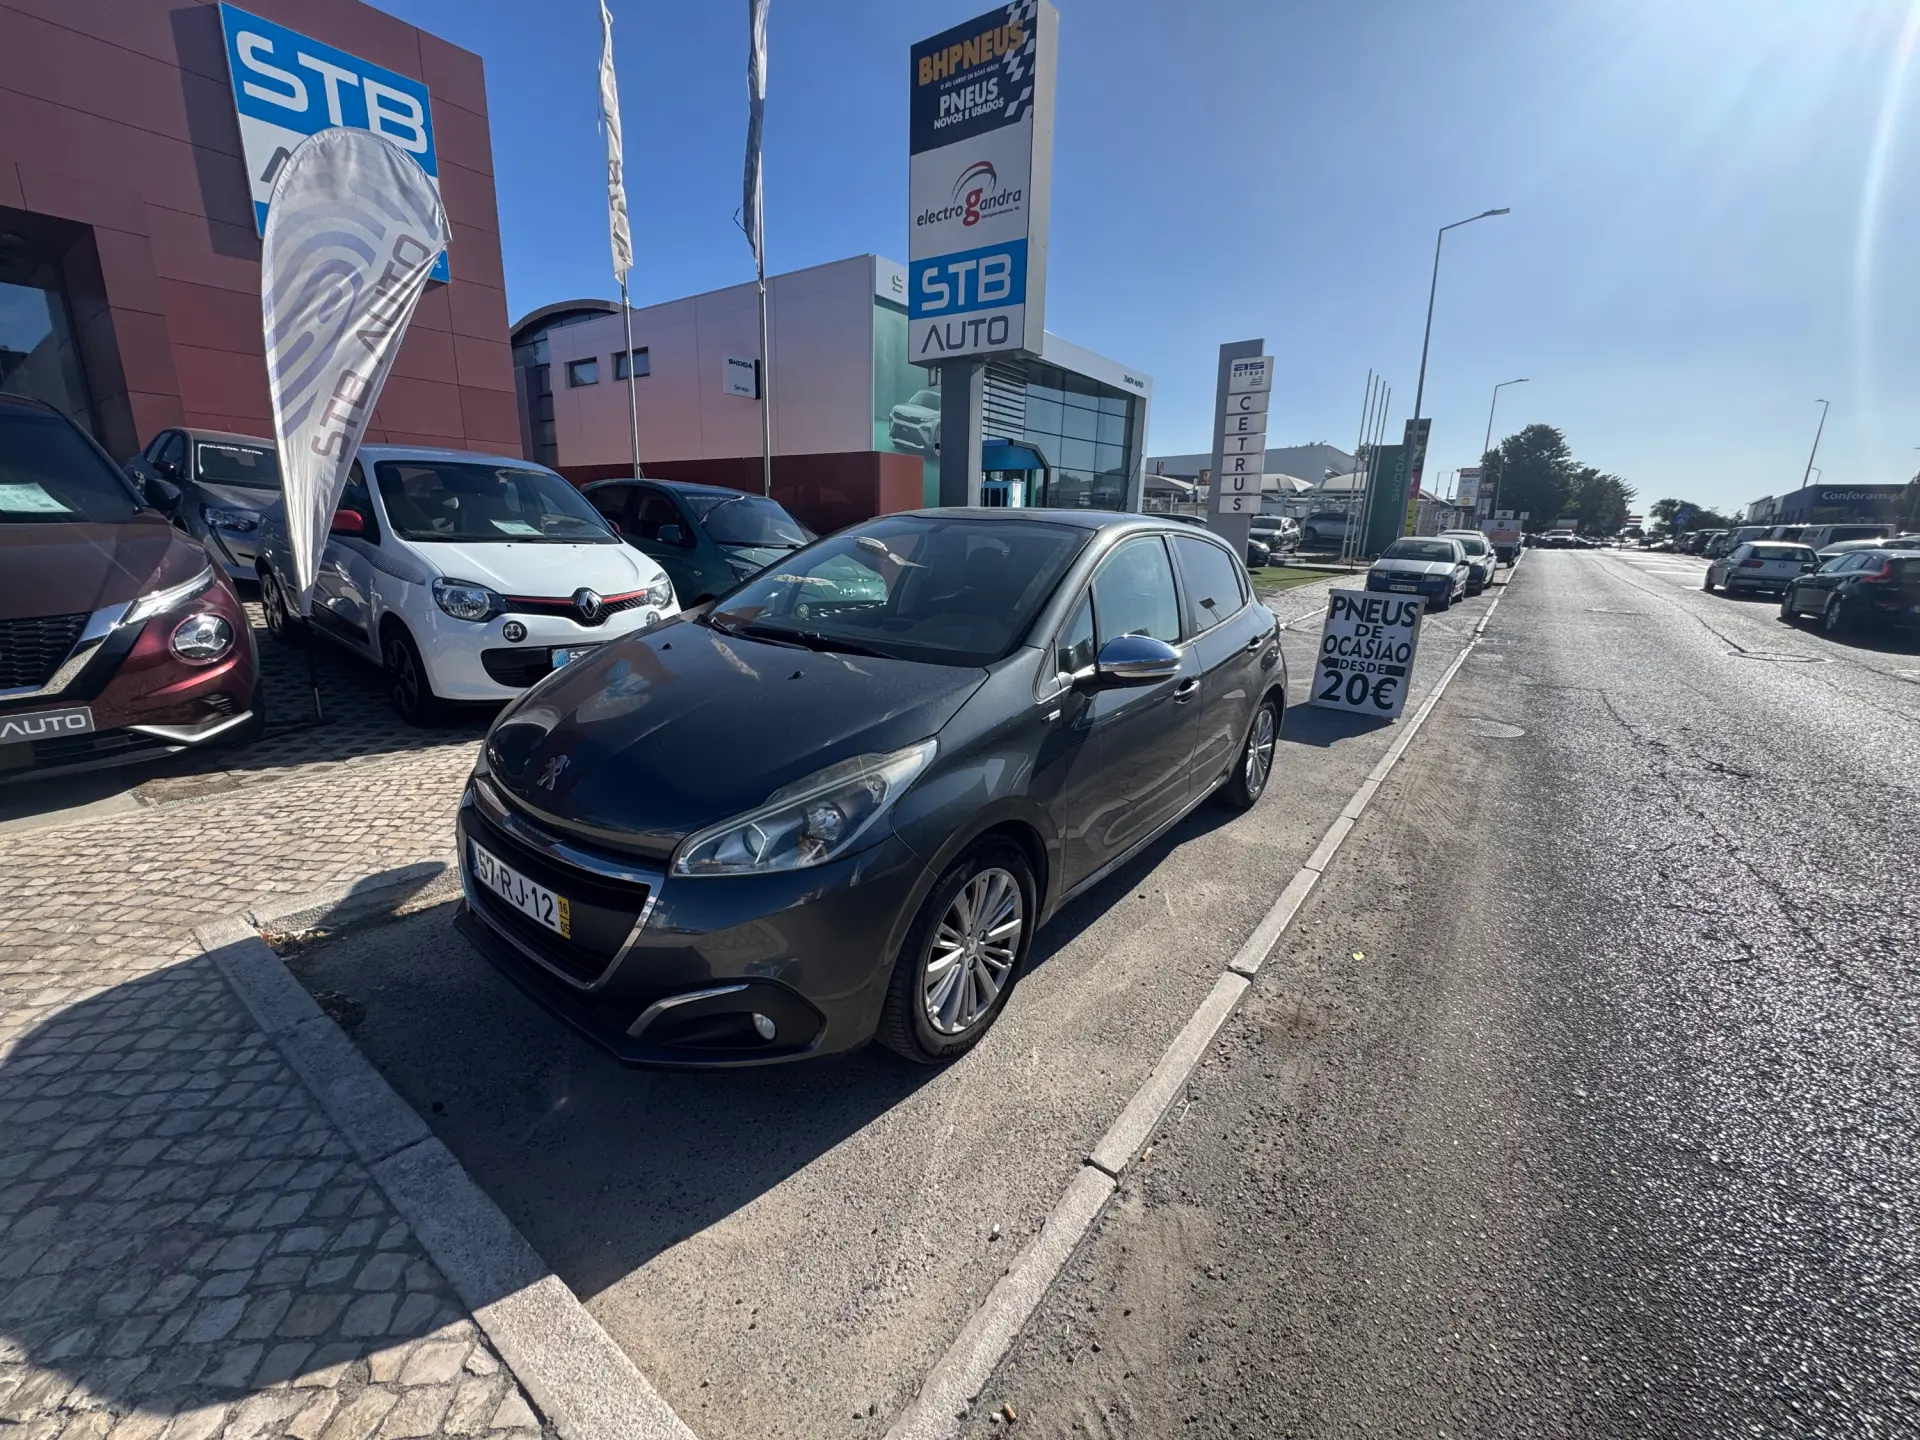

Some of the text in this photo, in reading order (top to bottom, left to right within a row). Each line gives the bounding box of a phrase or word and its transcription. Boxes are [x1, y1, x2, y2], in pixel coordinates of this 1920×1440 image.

[918, 20, 1024, 86] BHPNEUS
[236, 31, 428, 154] STB
[940, 77, 998, 117] PNEUS
[933, 96, 1004, 130] NOVOS E USADOS
[921, 253, 1012, 311] STB
[311, 233, 431, 463] STB AUTO
[921, 315, 1009, 354] AUTO
[1233, 370, 1264, 378] CETRUS
[1232, 396, 1252, 511] CETRUS
[1329, 595, 1418, 628] PNEUS
[1322, 634, 1412, 663] OCASIÃO
[1354, 624, 1384, 639] DE
[1339, 659, 1386, 675] DESDE
[1318, 669, 1398, 710] 20€
[0, 714, 86, 738] AUTO
[558, 900, 568, 915] 16
[560, 920, 571, 934] 05
